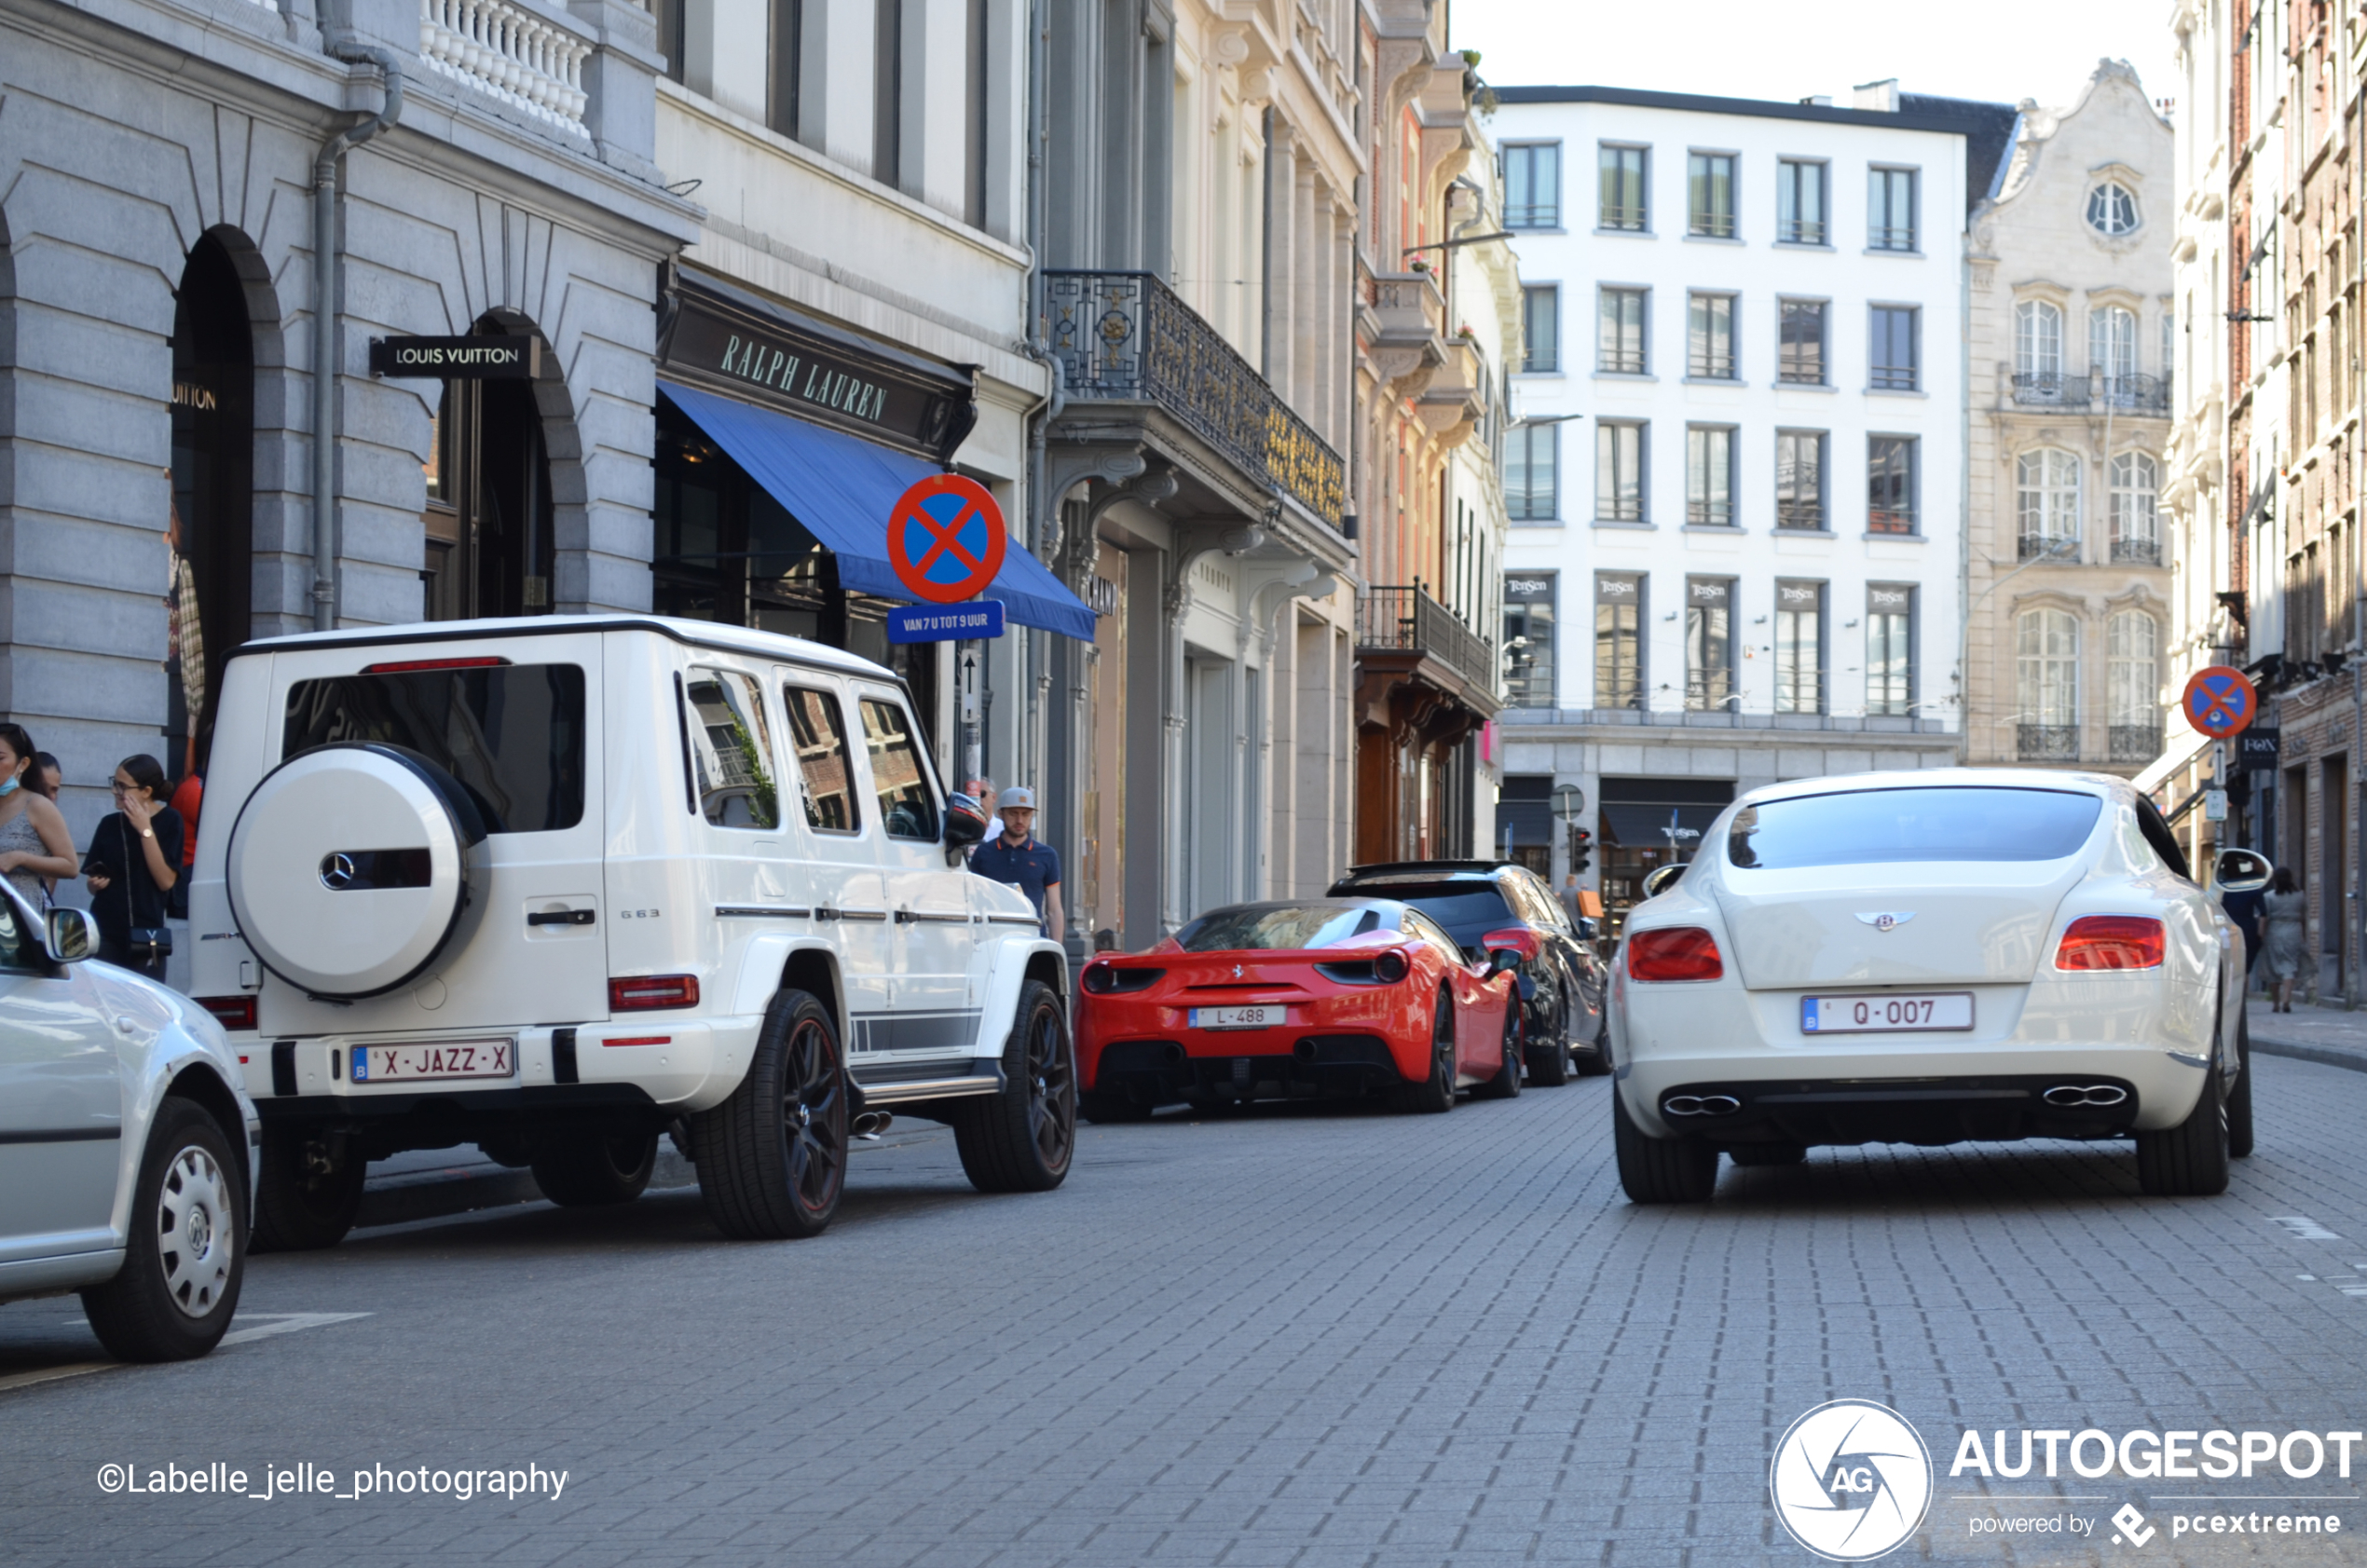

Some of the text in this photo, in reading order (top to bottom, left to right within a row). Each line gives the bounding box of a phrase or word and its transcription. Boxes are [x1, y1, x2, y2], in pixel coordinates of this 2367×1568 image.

[396, 348, 518, 364] LOUIS VUITTON
[721, 334, 887, 421] RALPH LAUREN
[903, 613, 988, 631] VAN 7 U TOT 9 UUR
[2244, 738, 2277, 752] FOX
[356, 1066, 366, 1077] B
